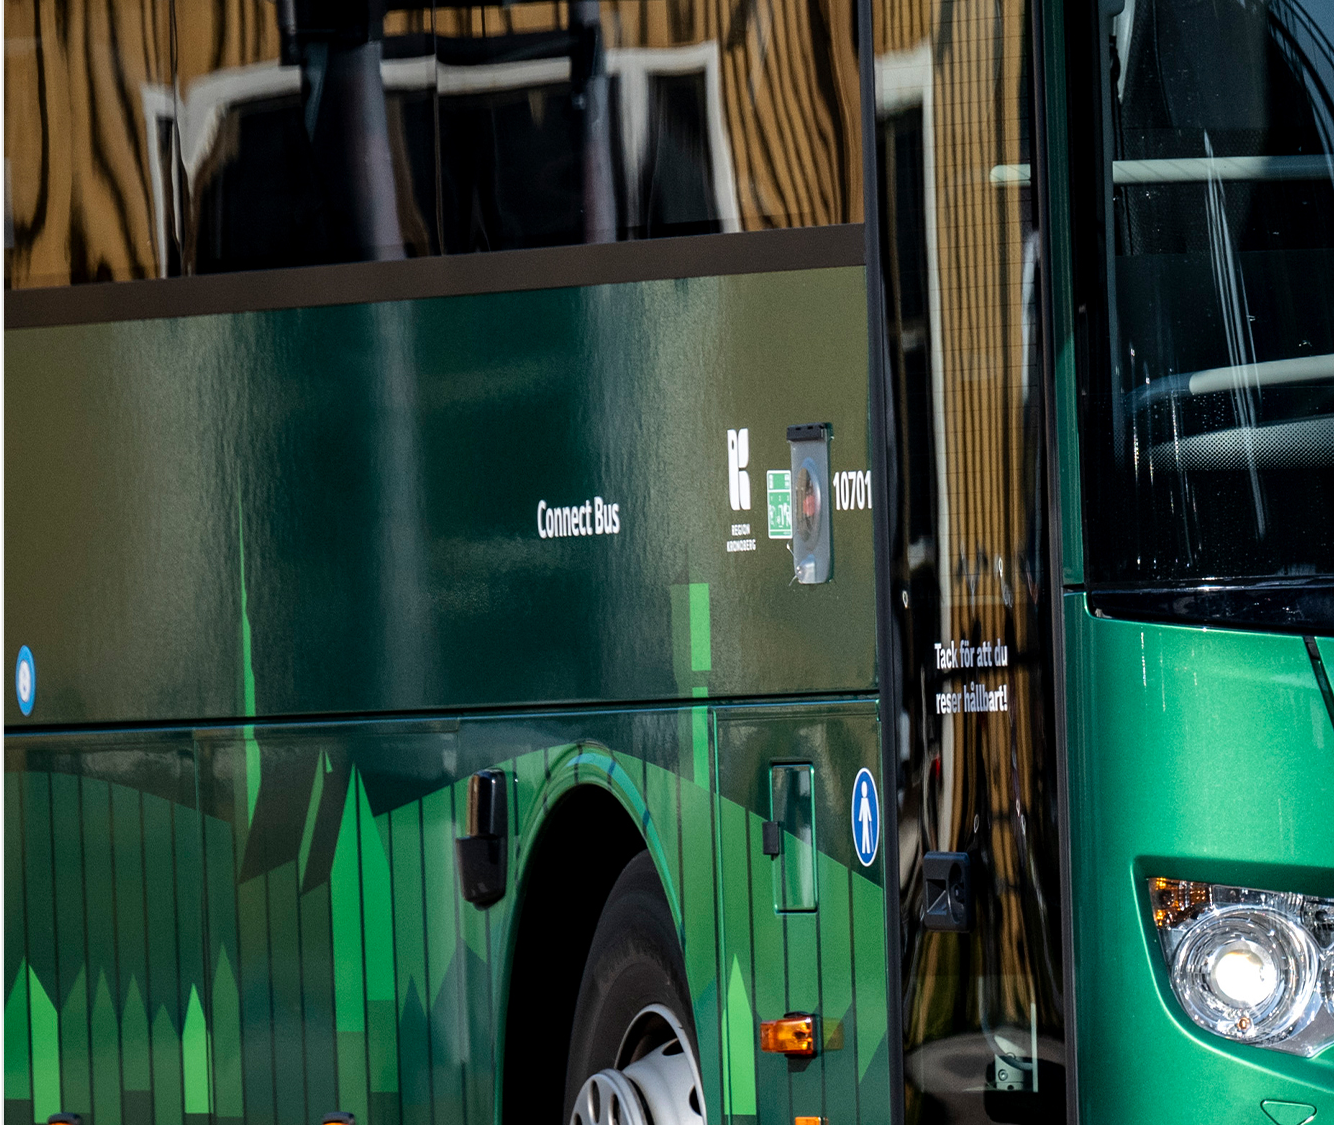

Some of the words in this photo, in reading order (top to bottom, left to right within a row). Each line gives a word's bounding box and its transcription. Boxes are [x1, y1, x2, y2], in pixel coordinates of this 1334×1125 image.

[832, 470, 873, 511] 10701
[537, 499, 593, 539] Connect
[594, 496, 620, 535] Bus
[731, 523, 751, 537] REGION
[934, 640, 959, 670] Tack
[960, 639, 975, 668] för
[976, 641, 993, 667] att
[994, 638, 1009, 667] du
[935, 692, 962, 715] reser
[963, 681, 1008, 712] hållbart!
